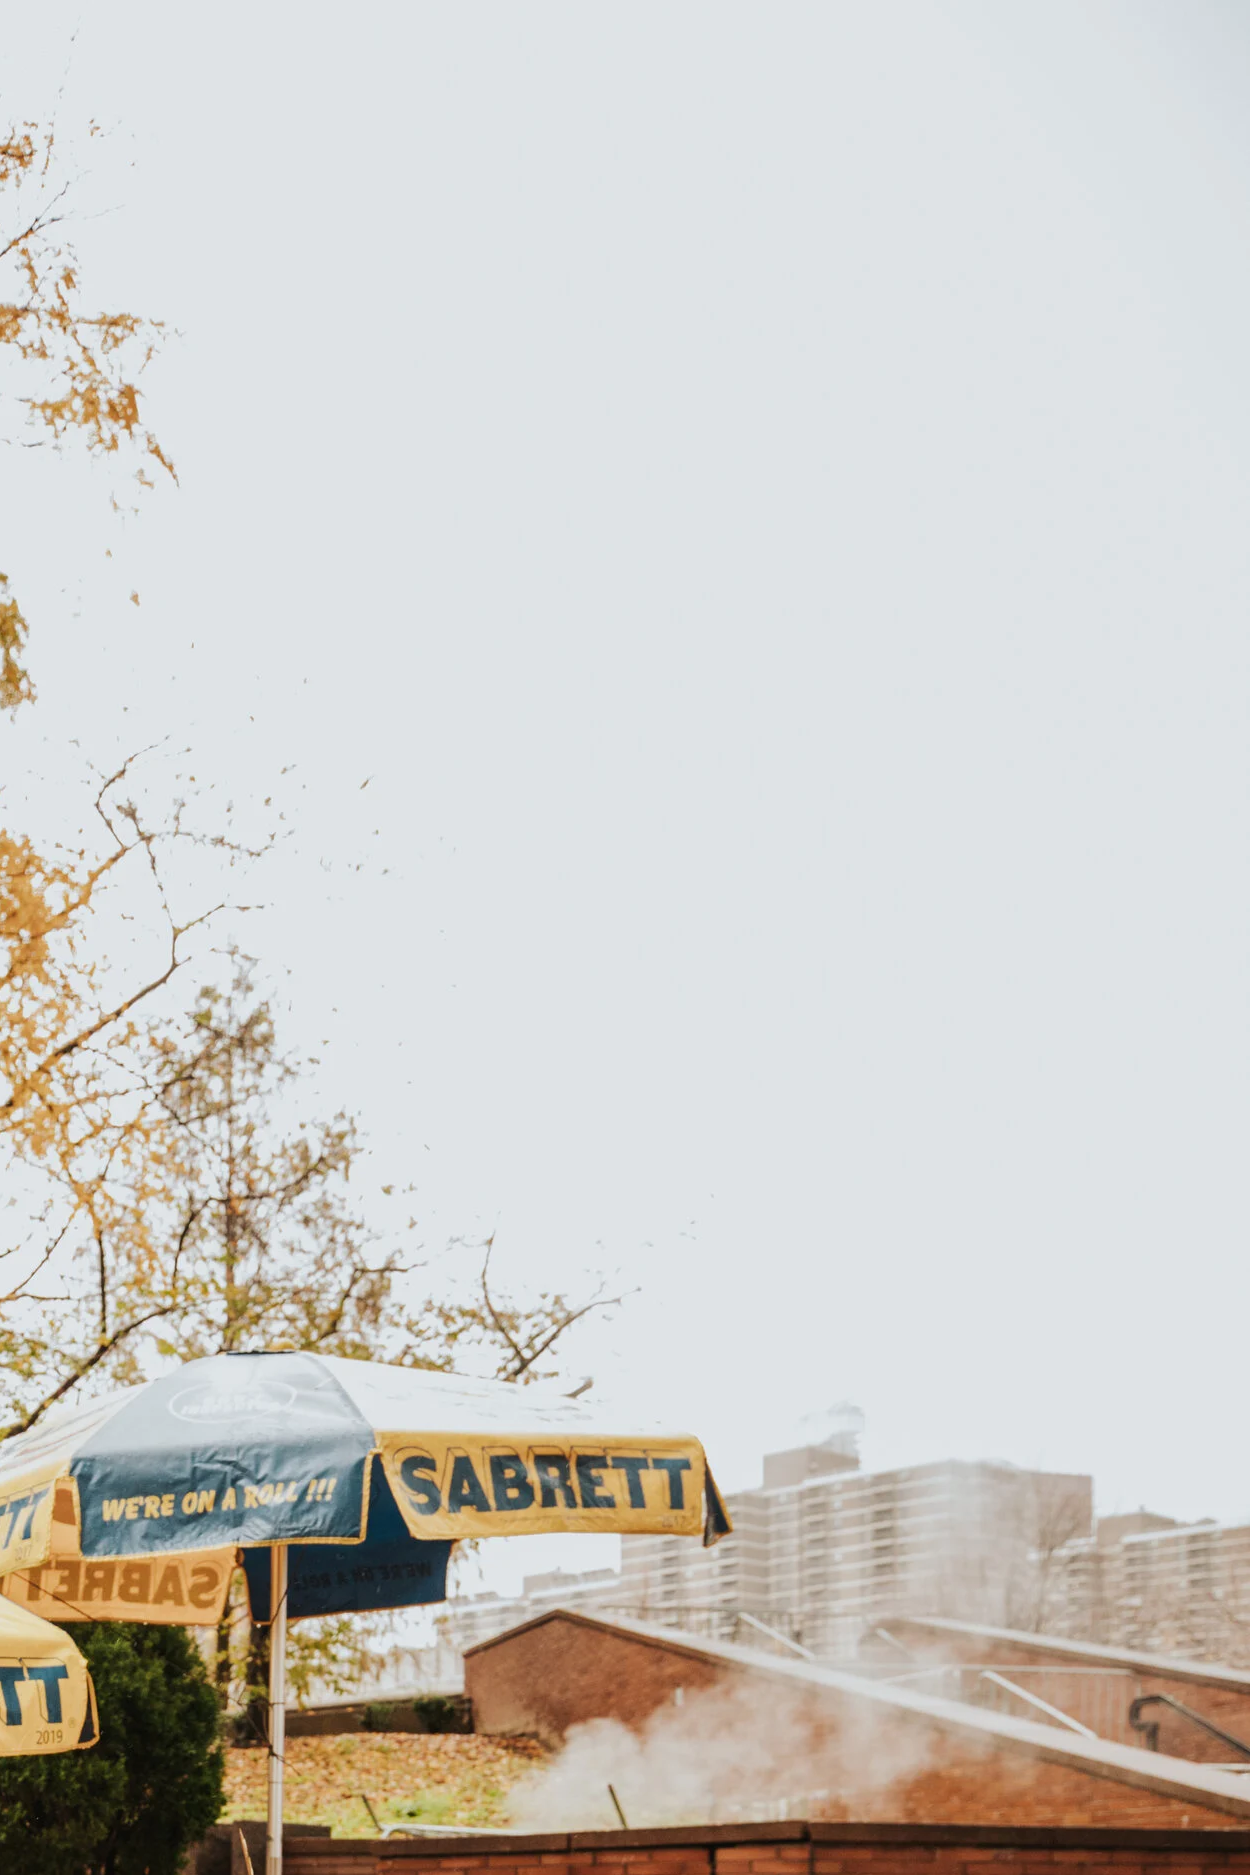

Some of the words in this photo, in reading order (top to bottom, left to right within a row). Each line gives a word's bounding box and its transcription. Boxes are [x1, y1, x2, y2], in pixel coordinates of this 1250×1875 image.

[102, 1493, 175, 1522] WE'RE
[181, 1489, 216, 1515] ON
[221, 1487, 237, 1511] A
[243, 1481, 299, 1509] ROLL
[306, 1478, 338, 1502] !!!
[393, 1446, 693, 1516] SABRETT
[35, 1730, 64, 1745] 2019
